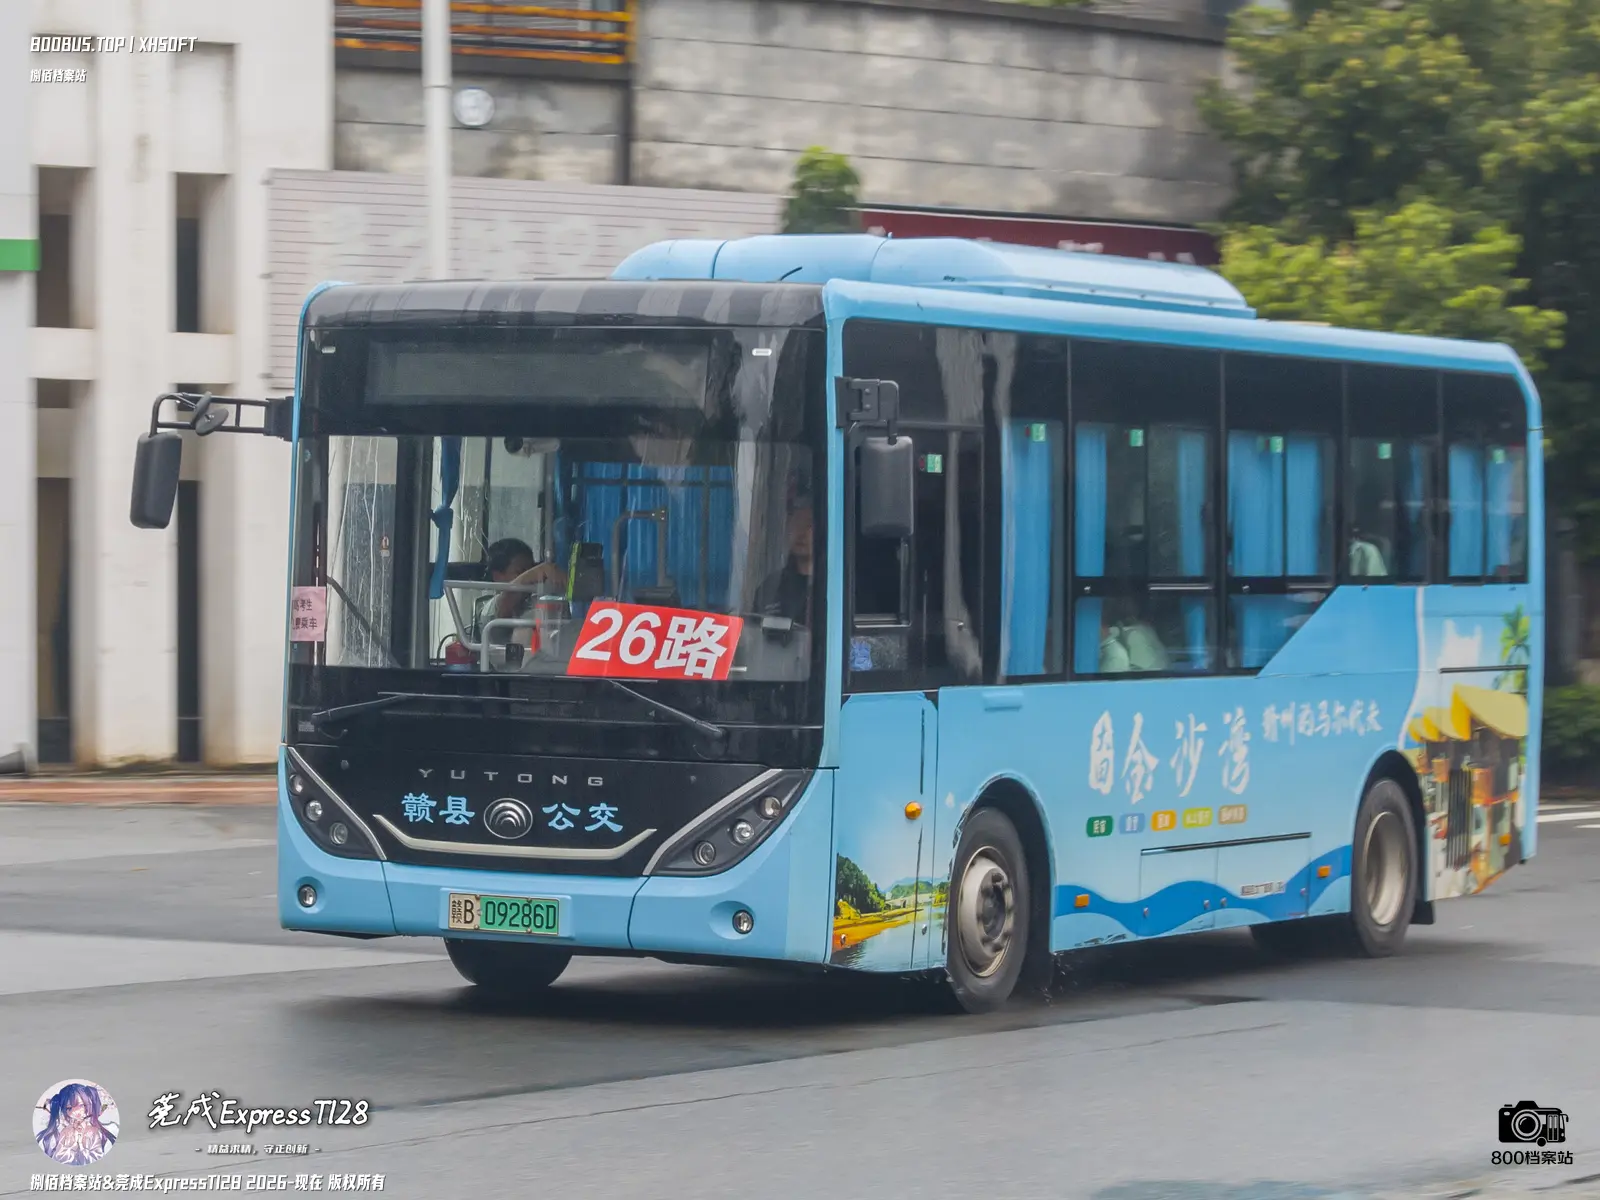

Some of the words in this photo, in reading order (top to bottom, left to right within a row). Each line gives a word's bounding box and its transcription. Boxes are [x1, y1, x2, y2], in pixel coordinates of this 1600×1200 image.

[576, 608, 729, 679] 26路
[418, 767, 605, 787] YUTONG
[401, 792, 476, 825] 赣县
[542, 802, 624, 832] 公交
